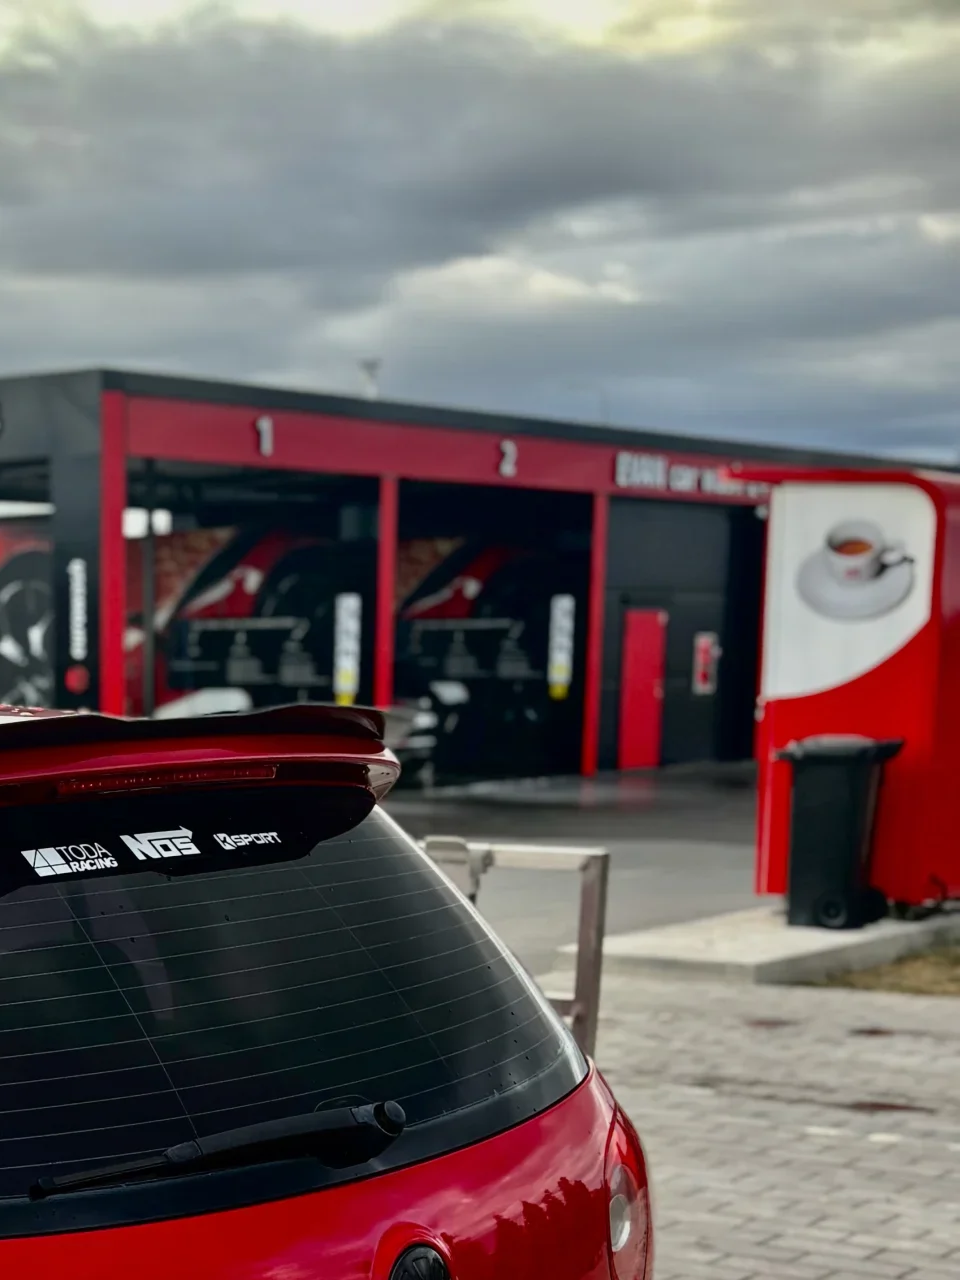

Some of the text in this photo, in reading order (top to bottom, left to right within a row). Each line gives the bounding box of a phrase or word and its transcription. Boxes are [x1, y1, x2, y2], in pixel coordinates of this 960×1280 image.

[255, 415, 274, 458] 1
[498, 439, 519, 479] 2
[58, 842, 112, 863] TODA
[119, 825, 201, 861] NOS
[69, 857, 118, 873] RACING
